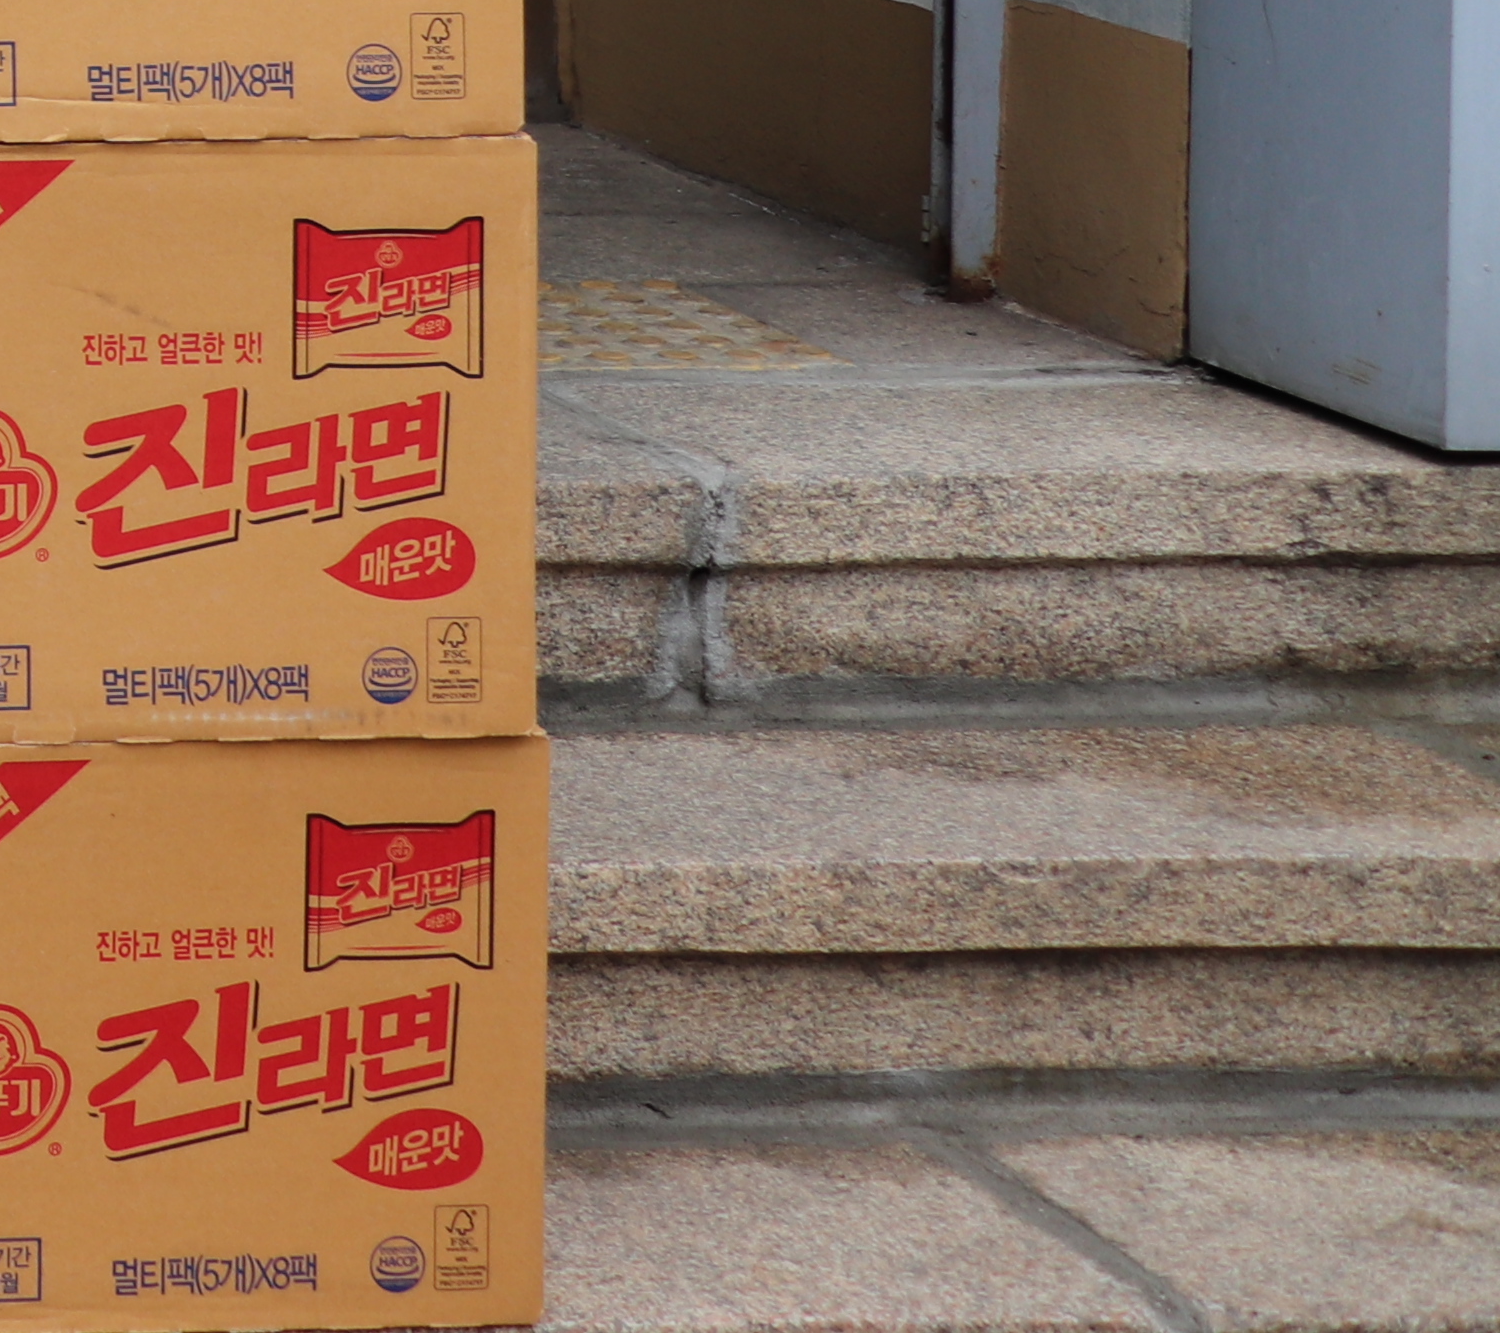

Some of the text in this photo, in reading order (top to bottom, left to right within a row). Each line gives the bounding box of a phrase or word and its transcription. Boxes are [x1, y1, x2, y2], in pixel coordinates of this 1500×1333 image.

[76, 387, 450, 569] 진라면
[360, 530, 456, 587] 매운맛
[101, 665, 310, 706] 멀티팩(5개)X8팩
[88, 981, 459, 1160] 진라면
[369, 1121, 464, 1176] 매운맛
[111, 1255, 318, 1296] 멀티팩(5개)X8팩
